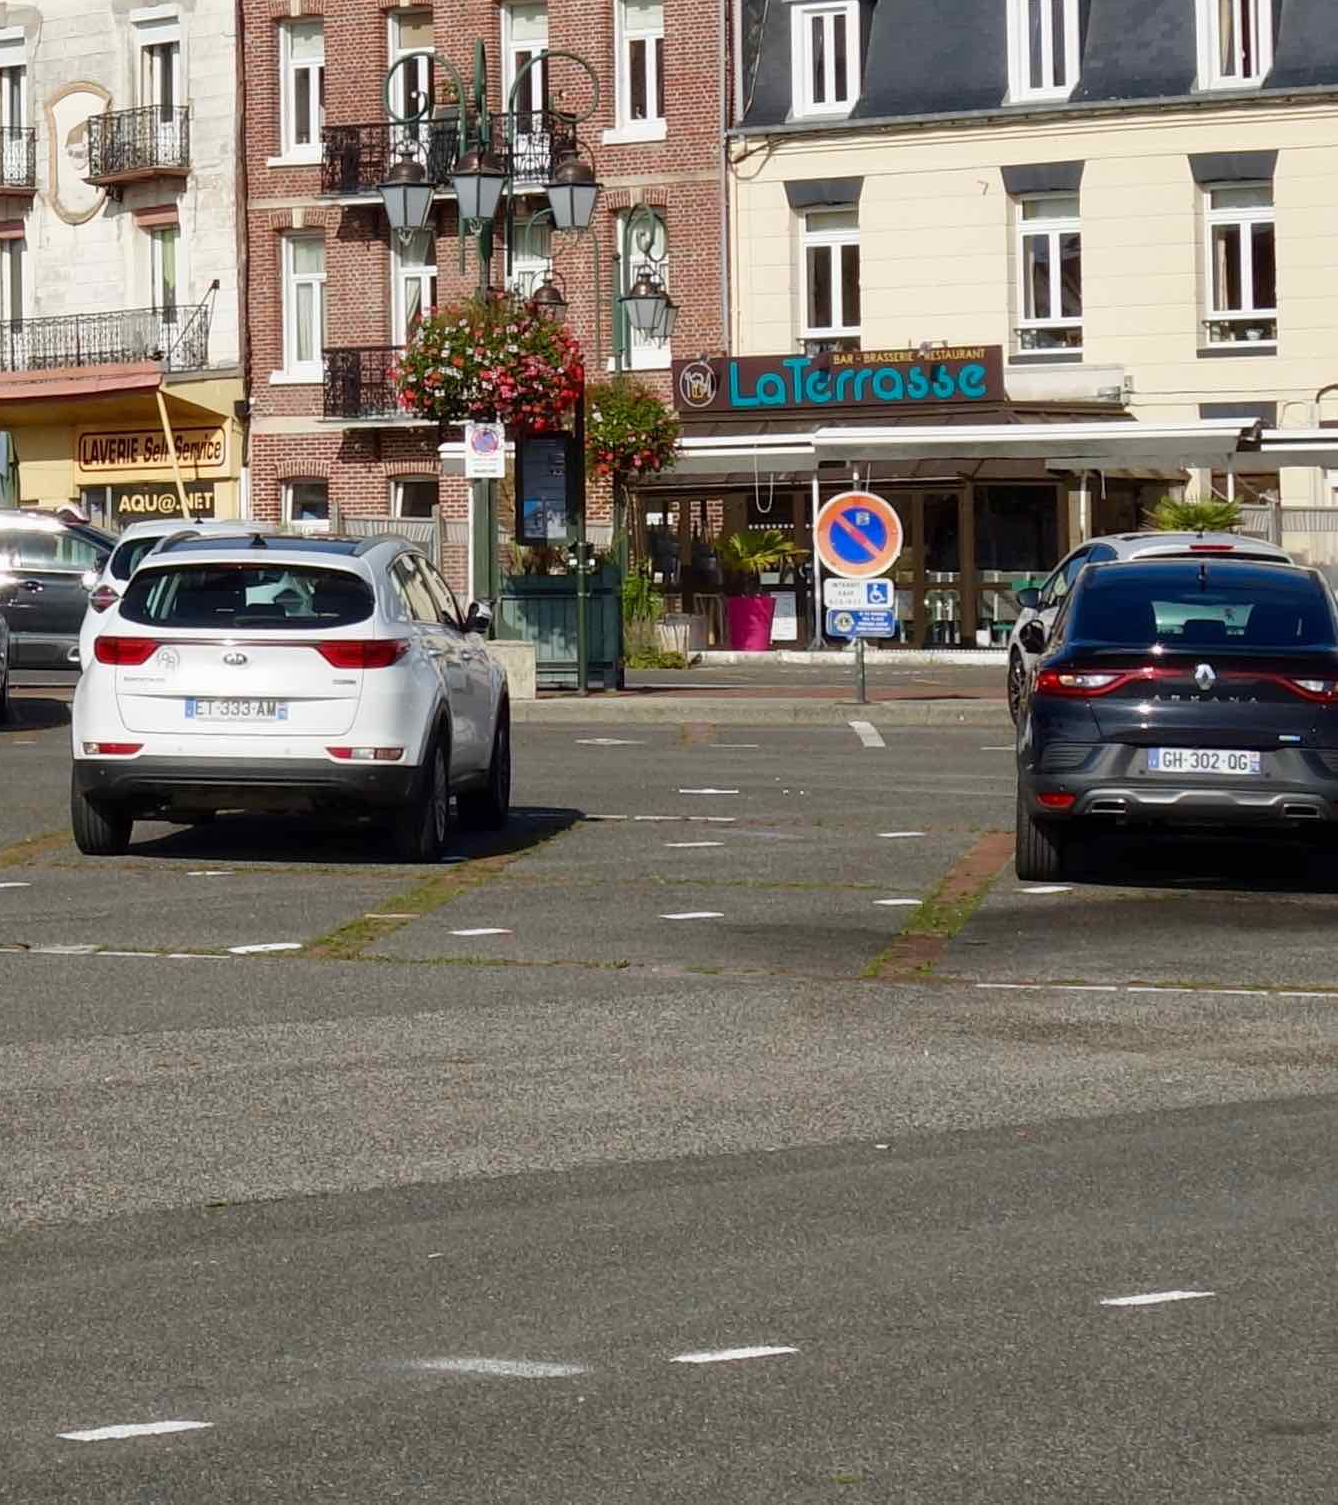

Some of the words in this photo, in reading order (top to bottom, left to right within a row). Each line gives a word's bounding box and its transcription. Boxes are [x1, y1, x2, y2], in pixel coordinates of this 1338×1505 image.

[833, 353, 854, 365] BAR
[863, 350, 914, 364] BRASSERIE
[83, 438, 139, 466] LAVERIE
[175, 433, 221, 461] Service
[195, 700, 276, 717] ET-333-AM
